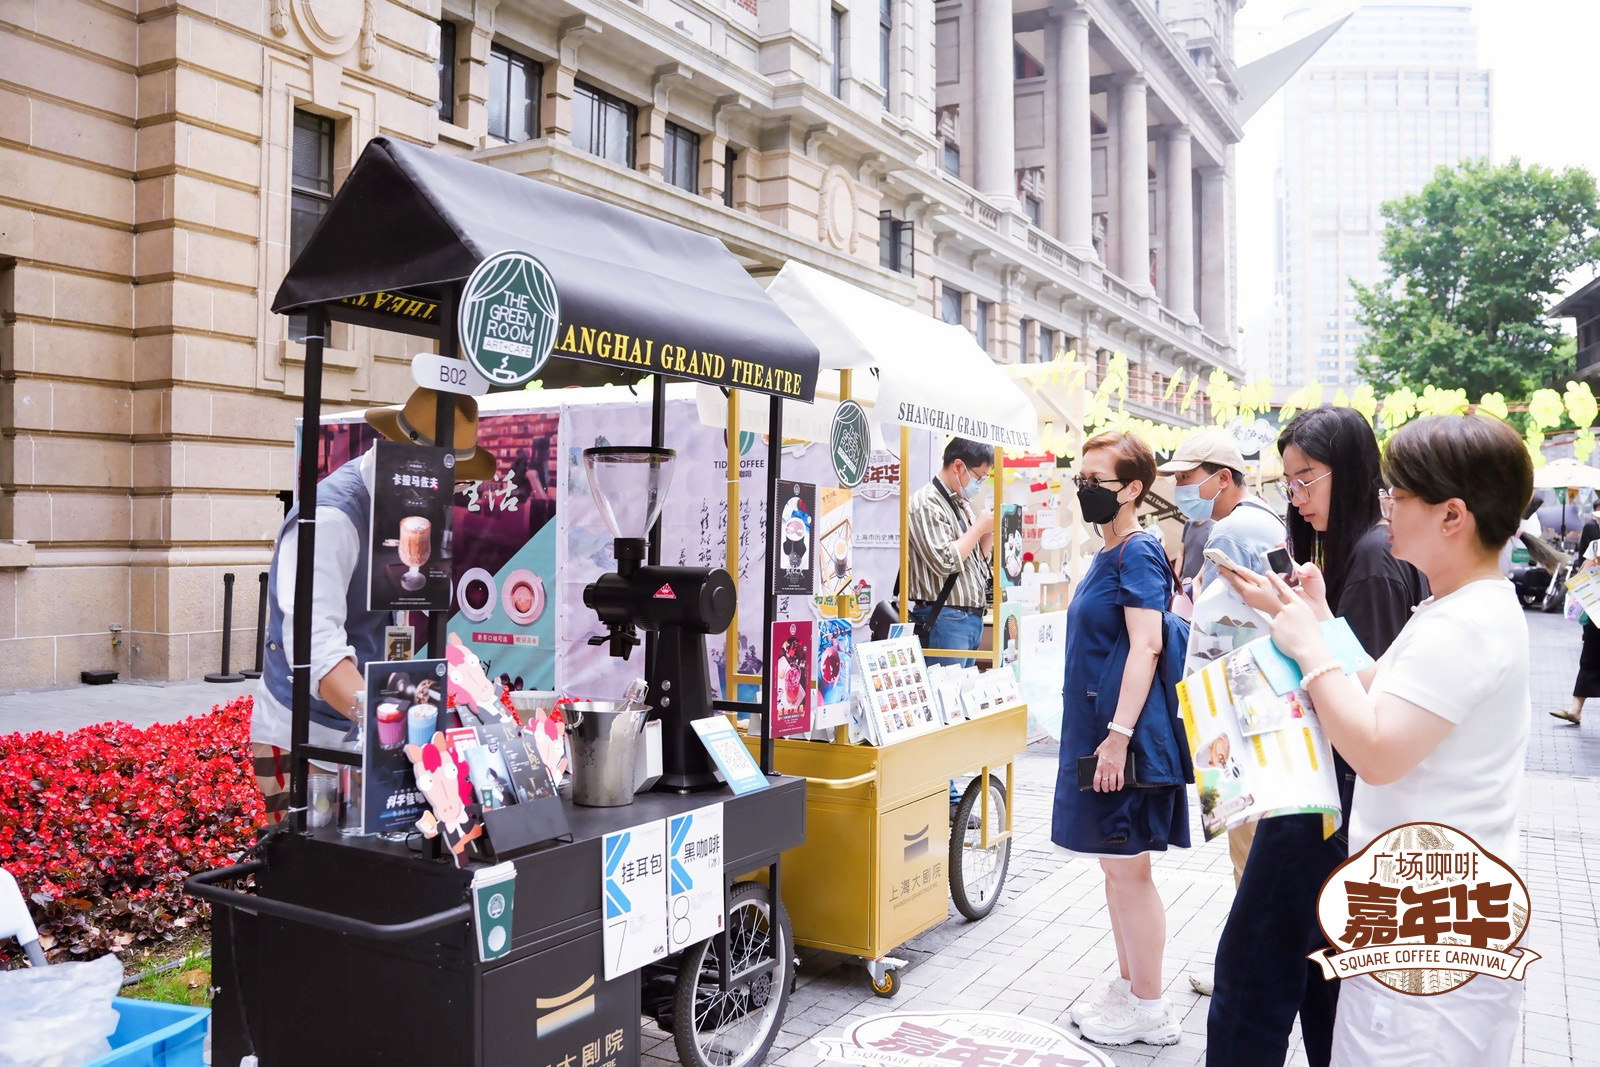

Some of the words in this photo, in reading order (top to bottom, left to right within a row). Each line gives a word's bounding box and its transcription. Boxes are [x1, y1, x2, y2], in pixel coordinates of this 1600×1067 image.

[503, 290, 530, 311] THE
[489, 304, 537, 328] GREEN
[486, 319, 536, 344] ROOM
[555, 322, 653, 366] ANGHAI
[660, 343, 726, 379] GRAND
[731, 358, 802, 396] THEATRE
[439, 365, 467, 386] B02
[897, 402, 955, 431] SHANGHAI
[957, 416, 988, 439] GRAND
[991, 424, 1030, 447] THEATRE
[392, 472, 439, 490] 卡拉马佐夫
[684, 834, 720, 864] 黑咖啡
[621, 854, 662, 885] 挂耳包
[889, 863, 941, 902] 上海大剧院
[673, 896, 691, 944] 8
[608, 920, 628, 972] 7
